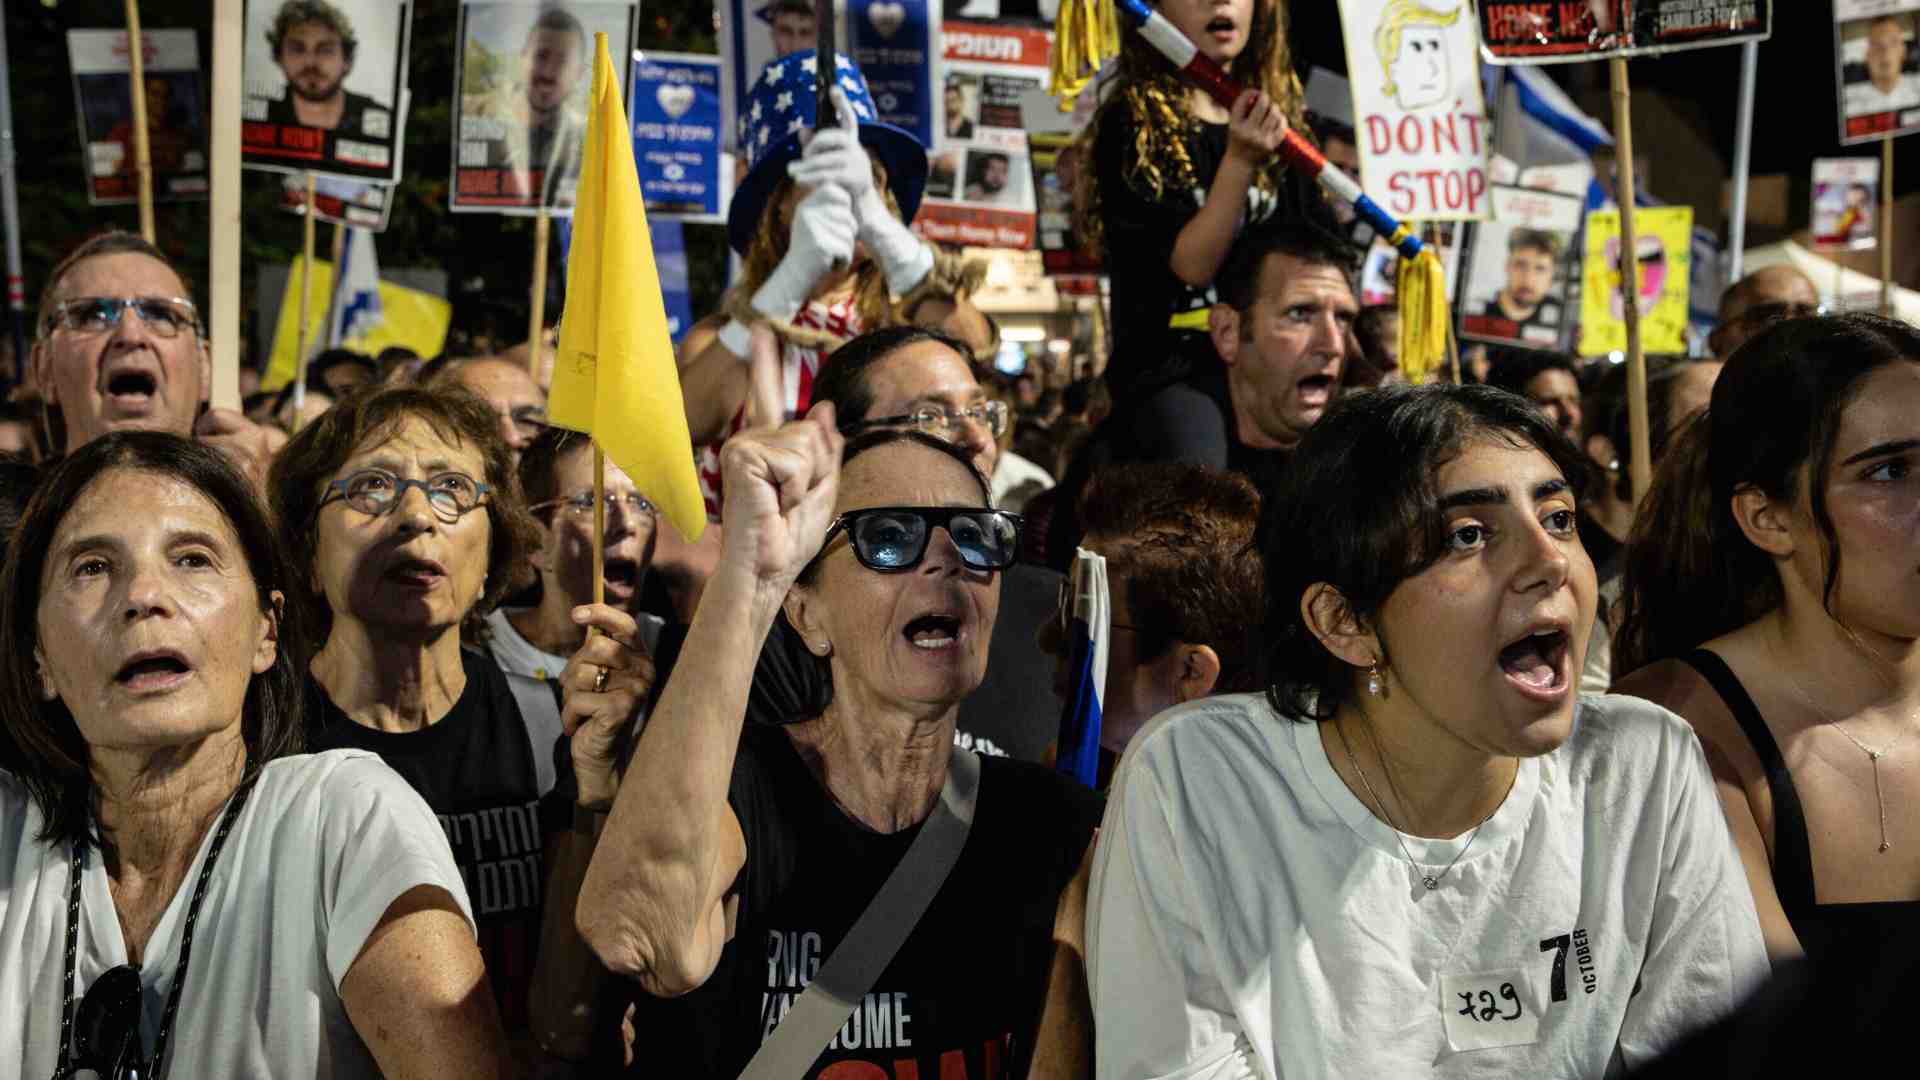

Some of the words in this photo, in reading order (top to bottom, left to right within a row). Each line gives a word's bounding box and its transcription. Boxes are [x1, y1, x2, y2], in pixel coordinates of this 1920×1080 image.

[1364, 100, 1488, 156] DON'T
[1388, 167, 1486, 214] STOP
[1540, 934, 1571, 1003] 7
[1573, 928, 1597, 994] OCTOBER
[1457, 982, 1522, 1022] 729
